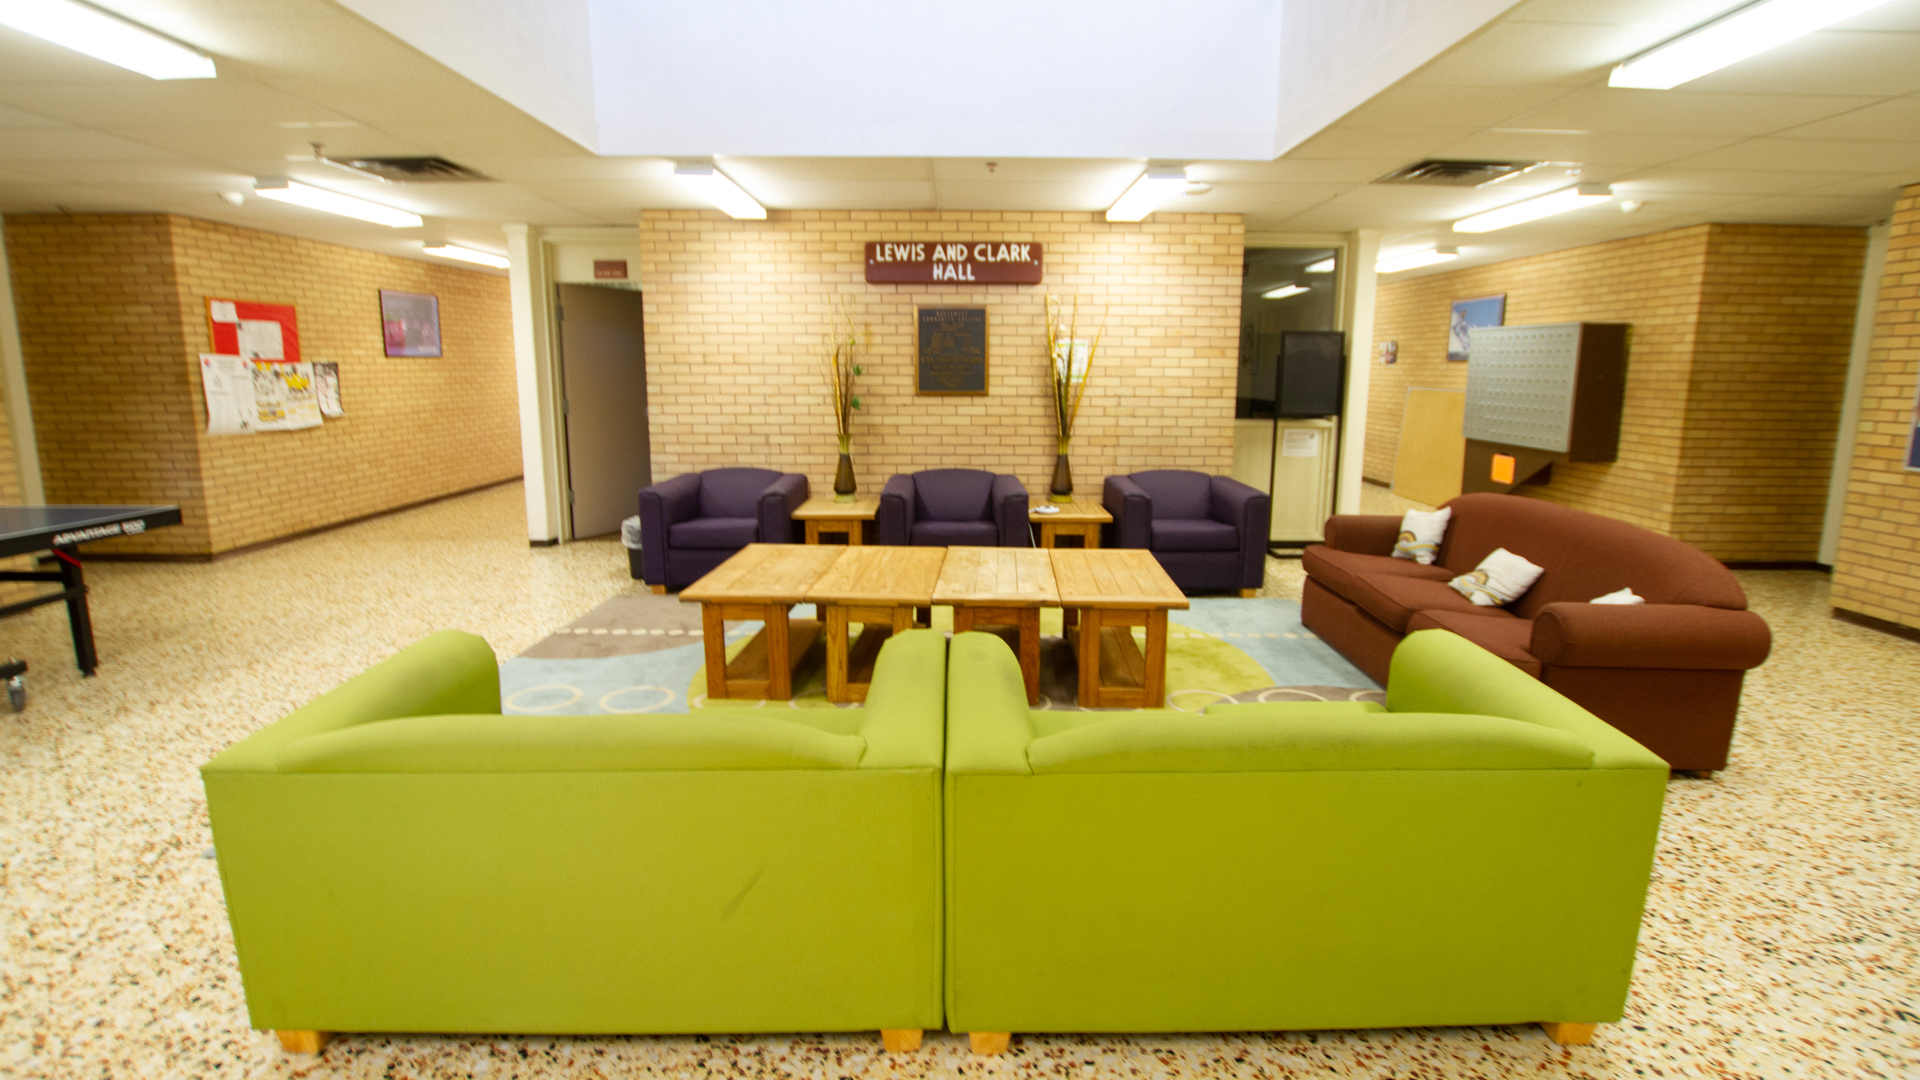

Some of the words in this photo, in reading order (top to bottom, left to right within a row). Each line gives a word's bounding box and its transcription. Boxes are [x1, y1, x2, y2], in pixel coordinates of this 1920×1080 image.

[876, 243, 926, 262] LEWIS
[932, 243, 968, 262] AND
[973, 243, 1031, 262] CLARK
[932, 262, 976, 281] HALL
[52, 523, 121, 546] ADVANTAGE
